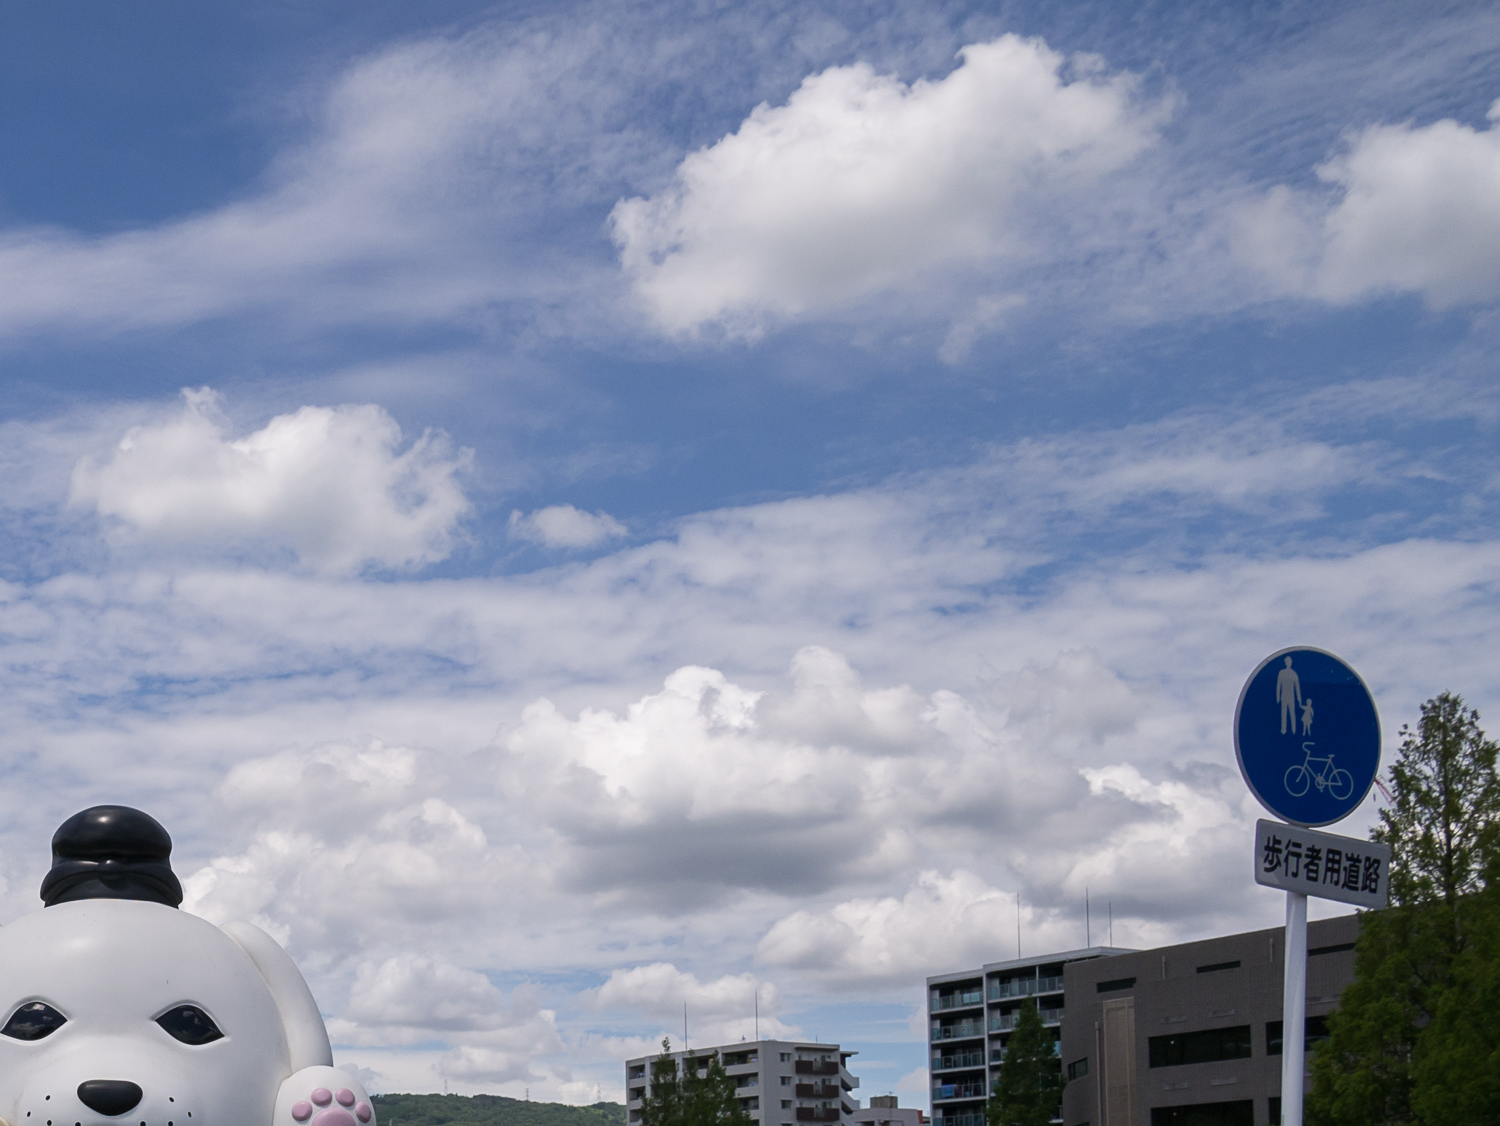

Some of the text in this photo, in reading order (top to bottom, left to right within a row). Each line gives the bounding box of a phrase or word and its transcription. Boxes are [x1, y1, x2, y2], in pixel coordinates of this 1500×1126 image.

[1263, 834, 1381, 894] 歩行者用道路
